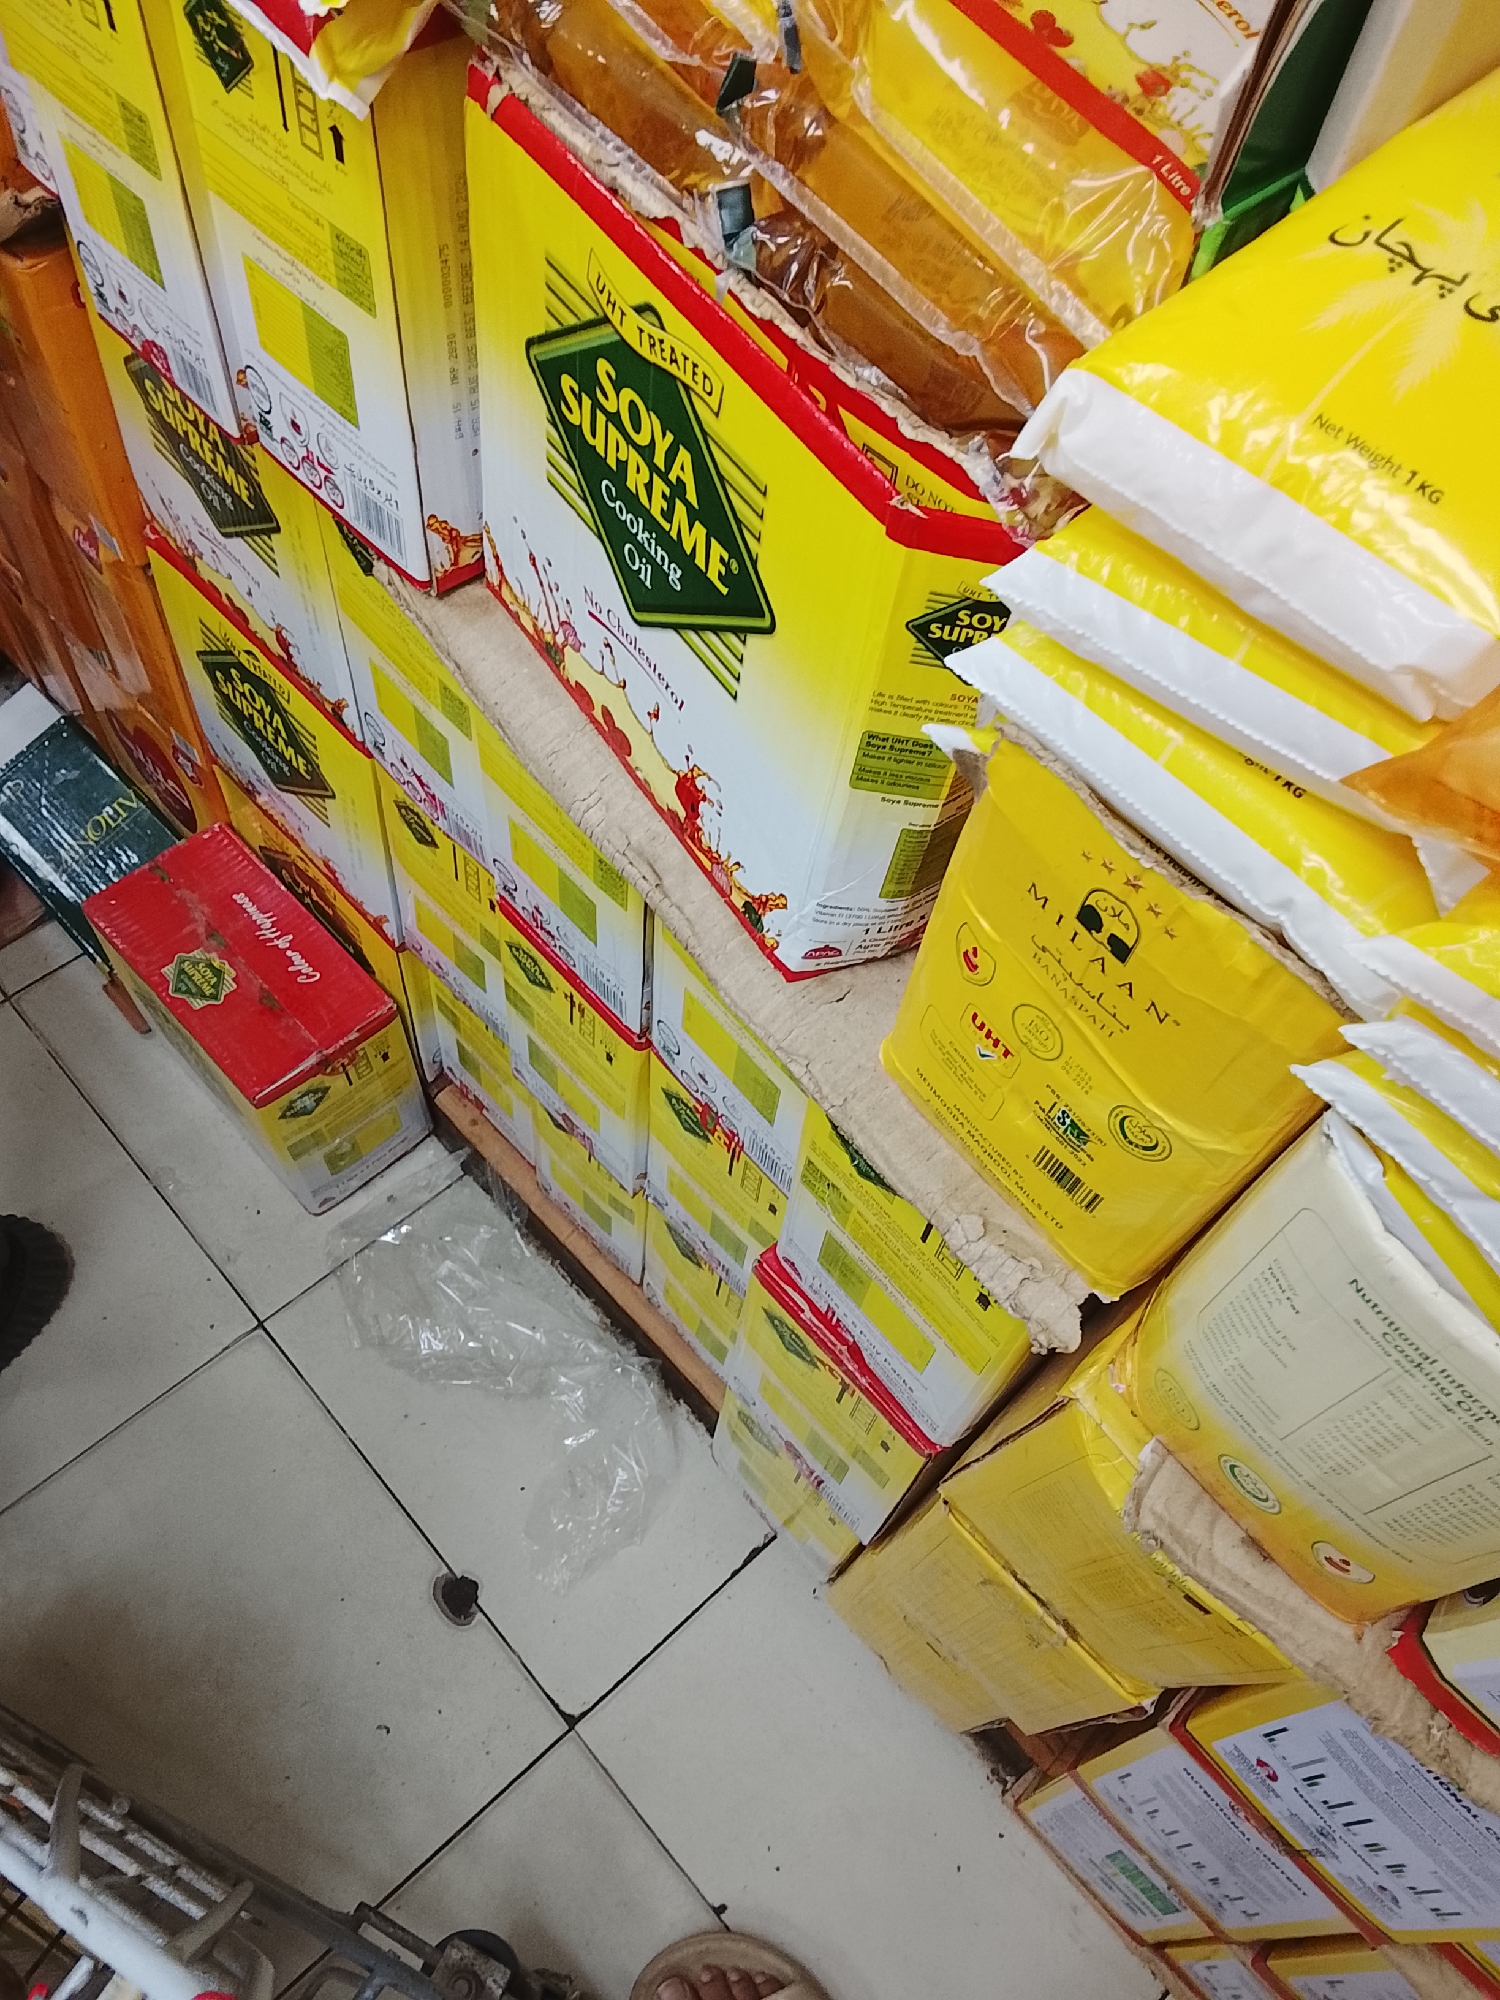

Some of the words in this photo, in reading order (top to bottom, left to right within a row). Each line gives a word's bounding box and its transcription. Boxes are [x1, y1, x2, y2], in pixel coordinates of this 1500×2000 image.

[1160, 163, 1192, 197] Litre
[594, 273, 628, 329] UHT
[635, 324, 715, 398] TREATED
[143, 378, 255, 511] SUPREME
[596, 357, 700, 511] SOYA
[1312, 412, 1344, 440] Net
[1345, 431, 1402, 478] Weight
[1404, 469, 1419, 486] 1
[1415, 480, 1445, 505] KG
[905, 474, 926, 496] DO
[600, 478, 683, 592] Cooking
[623, 542, 652, 590] Oil
[928, 623, 989, 643] SUPR
[956, 609, 1008, 632] SOY
[582, 585, 603, 614] No
[606, 608, 685, 712] Cholesterol
[230, 667, 288, 741] SOYA
[868, 706, 893, 715] makes
[870, 698, 888, 707] High
[889, 701, 933, 714] Temperature
[215, 670, 312, 781] SUPREME
[867, 732, 889, 743] What
[891, 736, 910, 745] UHT
[912, 738, 934, 749] Does
[862, 752, 886, 761] Makes
[865, 740, 887, 751] Soya
[888, 744, 933, 757] Supreme?
[856, 775, 879, 785] Makes
[858, 766, 882, 776] Makes
[1281, 780, 1306, 798] KG
[881, 796, 901, 806] Soya
[903, 799, 939, 809] Supreme
[232, 892, 281, 940] Happiness
[876, 921, 914, 934] Litre
[265, 934, 294, 949] of
[1027, 881, 1171, 1025] MILAAN
[181, 960, 215, 997] SUPREME
[194, 961, 218, 986] SOYA
[971, 1011, 1015, 1059] UHT
[1028, 1019, 1049, 1042] ISO
[916, 1067, 966, 1130] MEHMOODA
[966, 1129, 1013, 1182] MAQBOOL
[1014, 1180, 1043, 1211] MILLS
[1044, 1210, 1064, 1230] LTD
[953, 1103, 1013, 1169] MANUFACTURED
[1267, 1263, 1287, 1294] Total
[1286, 1296, 1301, 1315] Fat
[1347, 1277, 1439, 1366] Nutritional
[1353, 1318, 1393, 1358] Serving
[1381, 1331, 1453, 1398] Cooking
[1456, 1400, 1485, 1423] Oil
